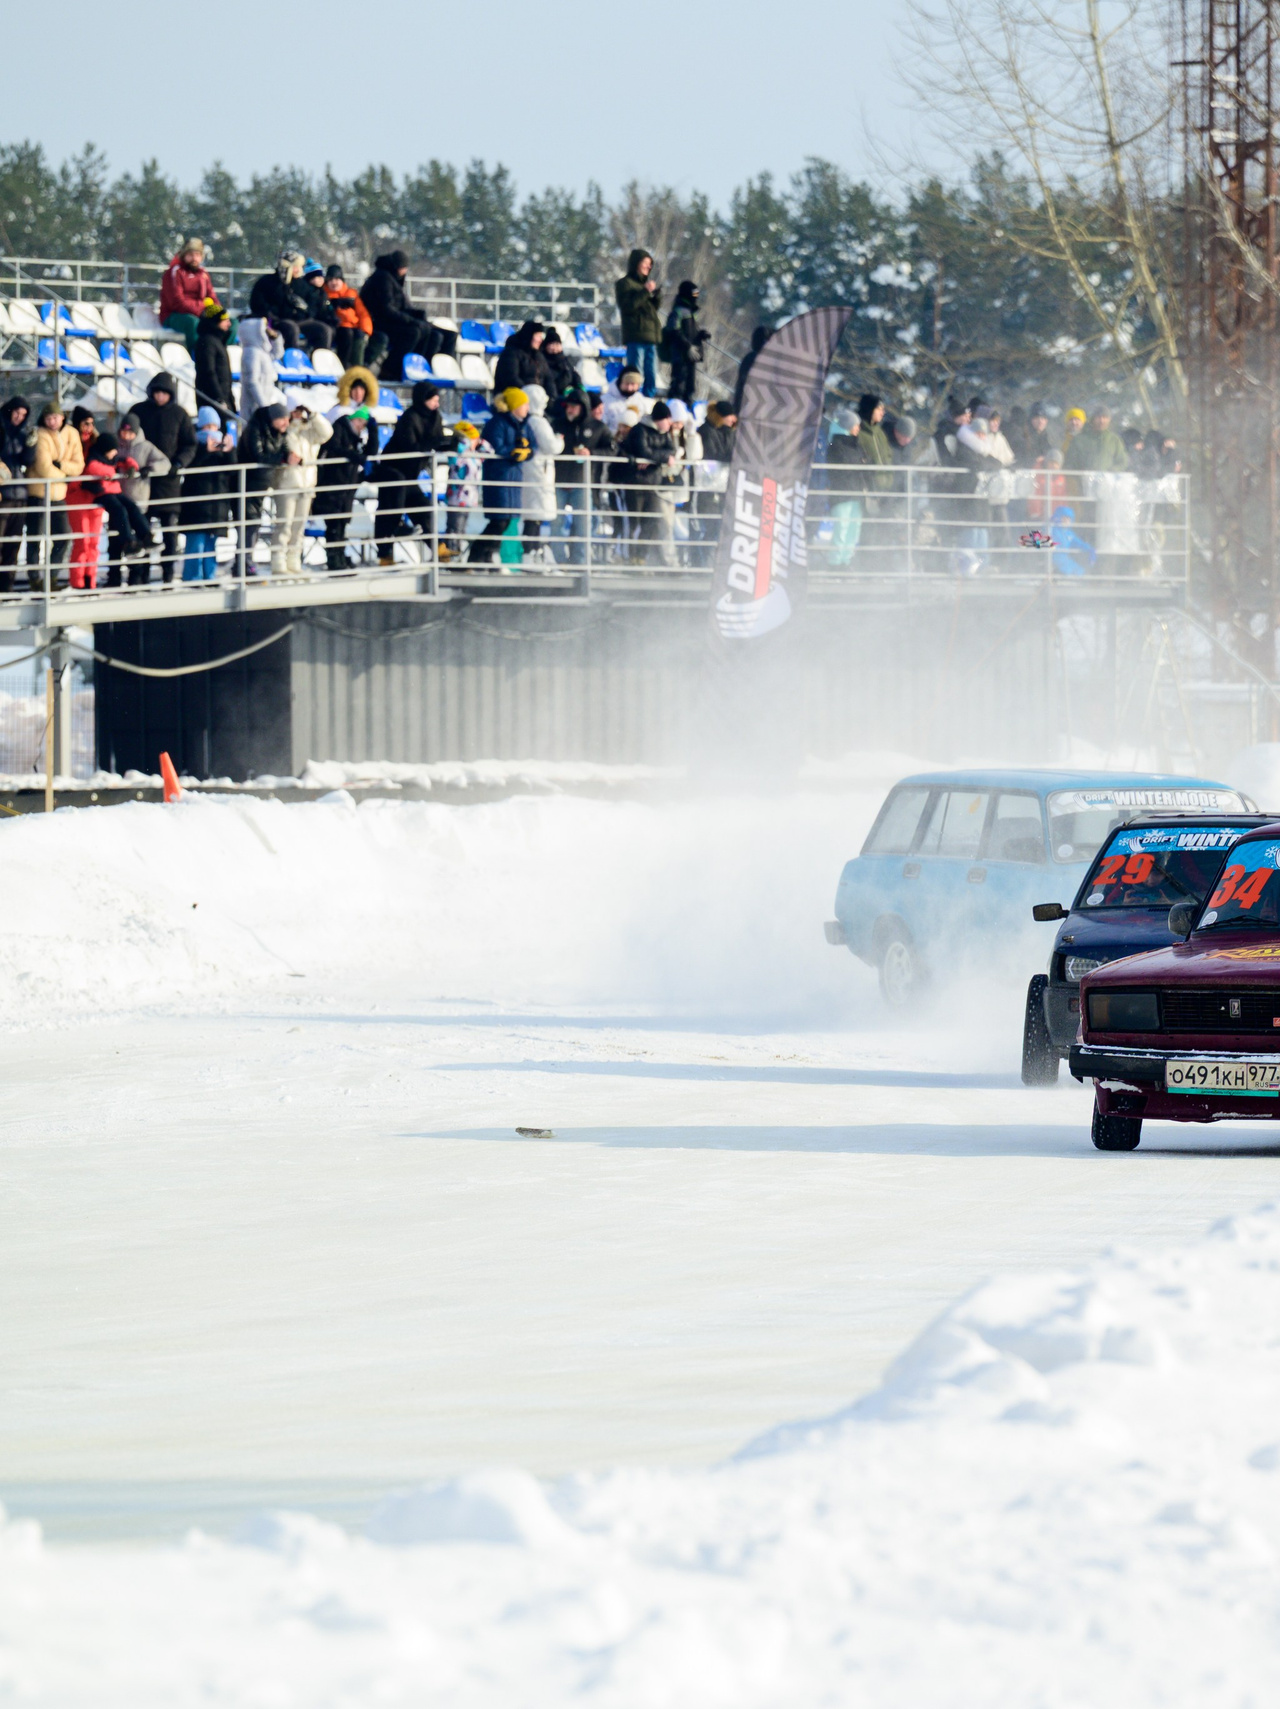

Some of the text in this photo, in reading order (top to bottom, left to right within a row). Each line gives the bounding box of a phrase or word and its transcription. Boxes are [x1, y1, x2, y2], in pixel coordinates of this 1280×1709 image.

[727, 469, 763, 595] DRIFT
[761, 491, 775, 539] EXPO
[770, 483, 795, 579] TRACK
[1114, 791, 1174, 806] WINTER
[1174, 792, 1219, 808] MODE
[1142, 835, 1177, 845] DRIFT
[1092, 853, 1155, 885] 29
[1208, 864, 1274, 909] 34
[1248, 1066, 1277, 1081] 977
